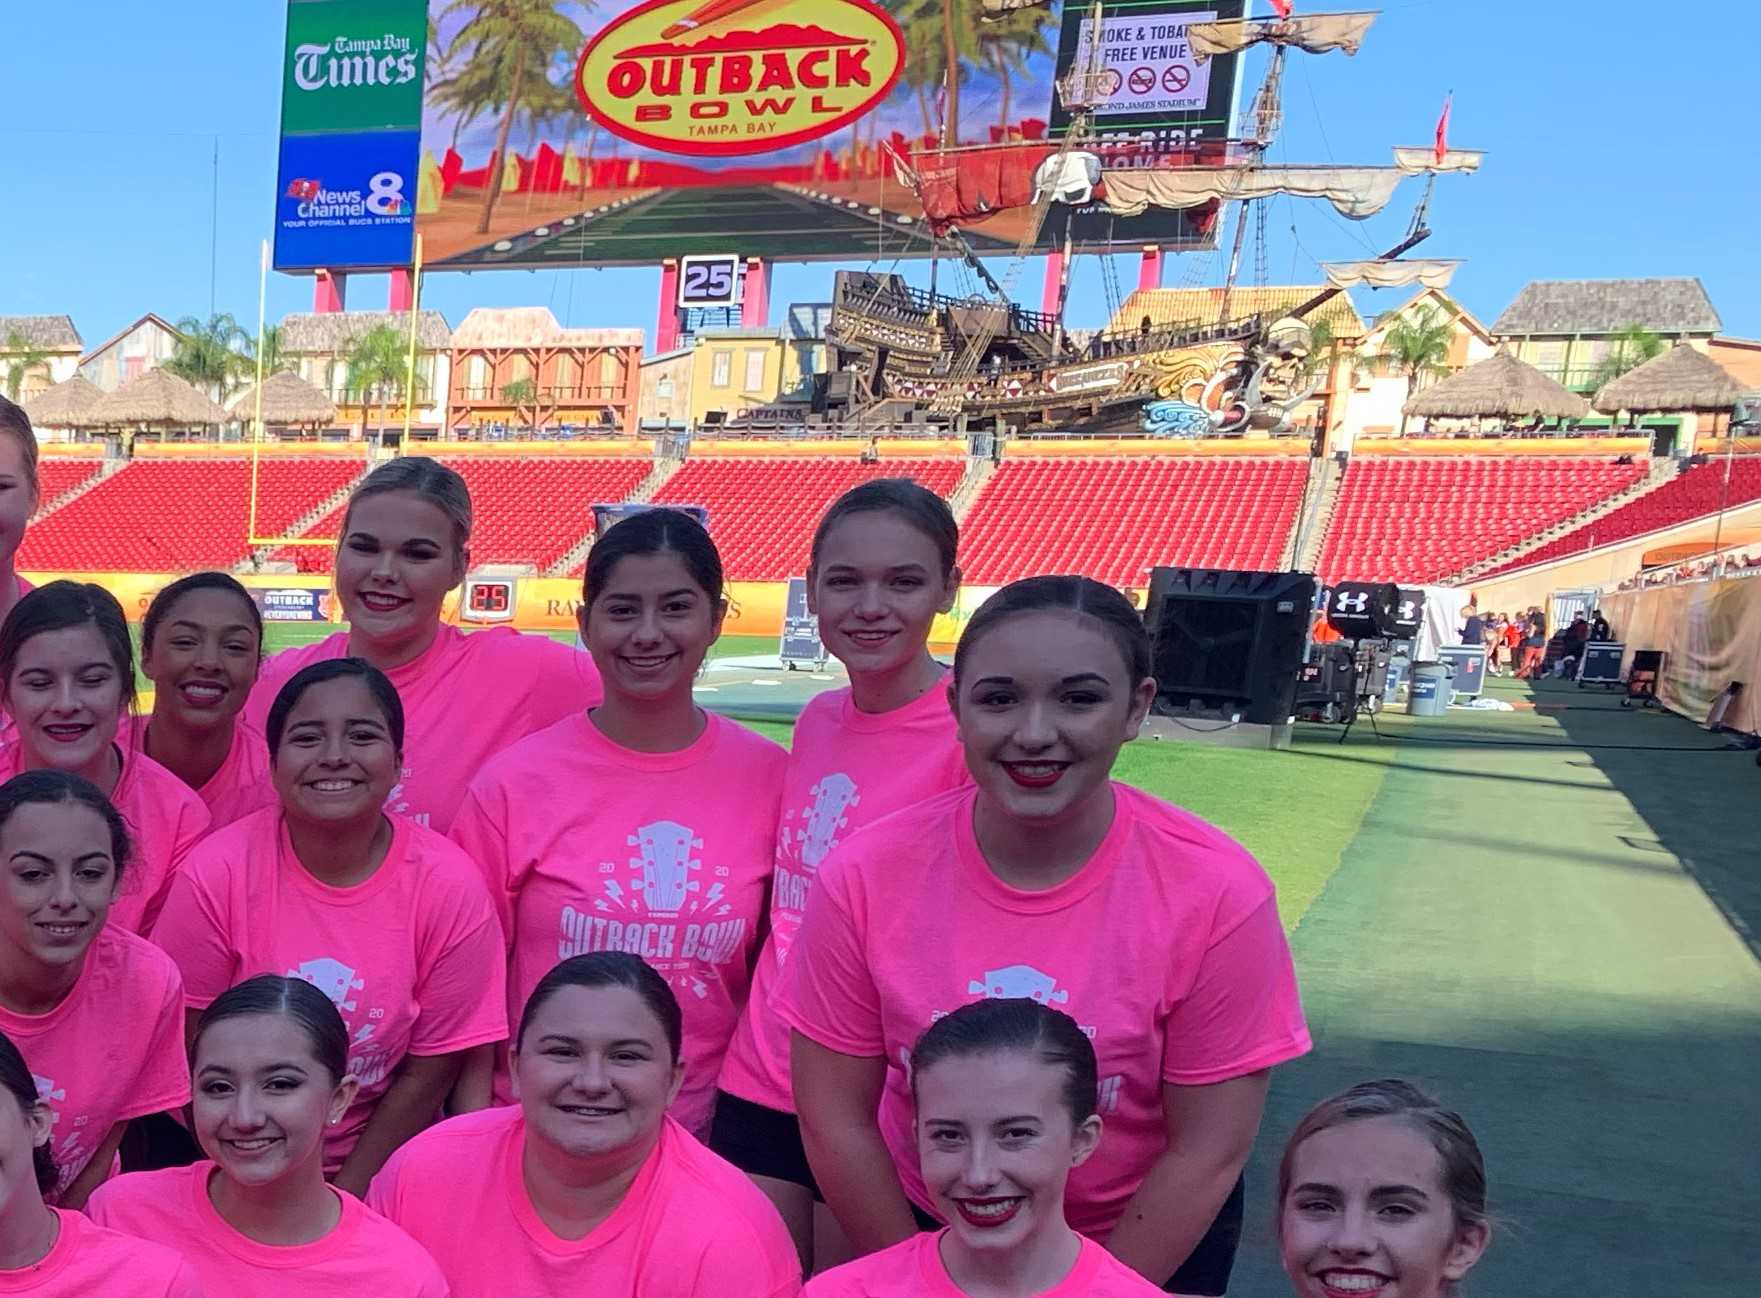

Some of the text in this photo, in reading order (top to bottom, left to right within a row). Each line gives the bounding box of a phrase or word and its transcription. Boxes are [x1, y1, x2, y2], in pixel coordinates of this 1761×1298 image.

[335, 33, 410, 55] Tampa Bay
[1085, 27, 1133, 44] SOKE
[1136, 27, 1146, 40] &
[1105, 44, 1188, 63] FREE VENUE
[294, 42, 418, 91] Times
[607, 47, 872, 99] OUTBACK
[635, 96, 843, 122] BOWL
[688, 121, 777, 136] TAMPA BAY
[313, 190, 361, 204] News
[366, 171, 405, 215] 8
[297, 200, 365, 218] Channel
[684, 264, 733, 298] 25
[263, 595, 314, 606] OUTBACK
[472, 584, 507, 612] 25
[598, 862, 615, 873] 20
[714, 865, 729, 877] 20
[558, 905, 676, 961] OUTBACK
[368, 1007, 385, 1018] 20
